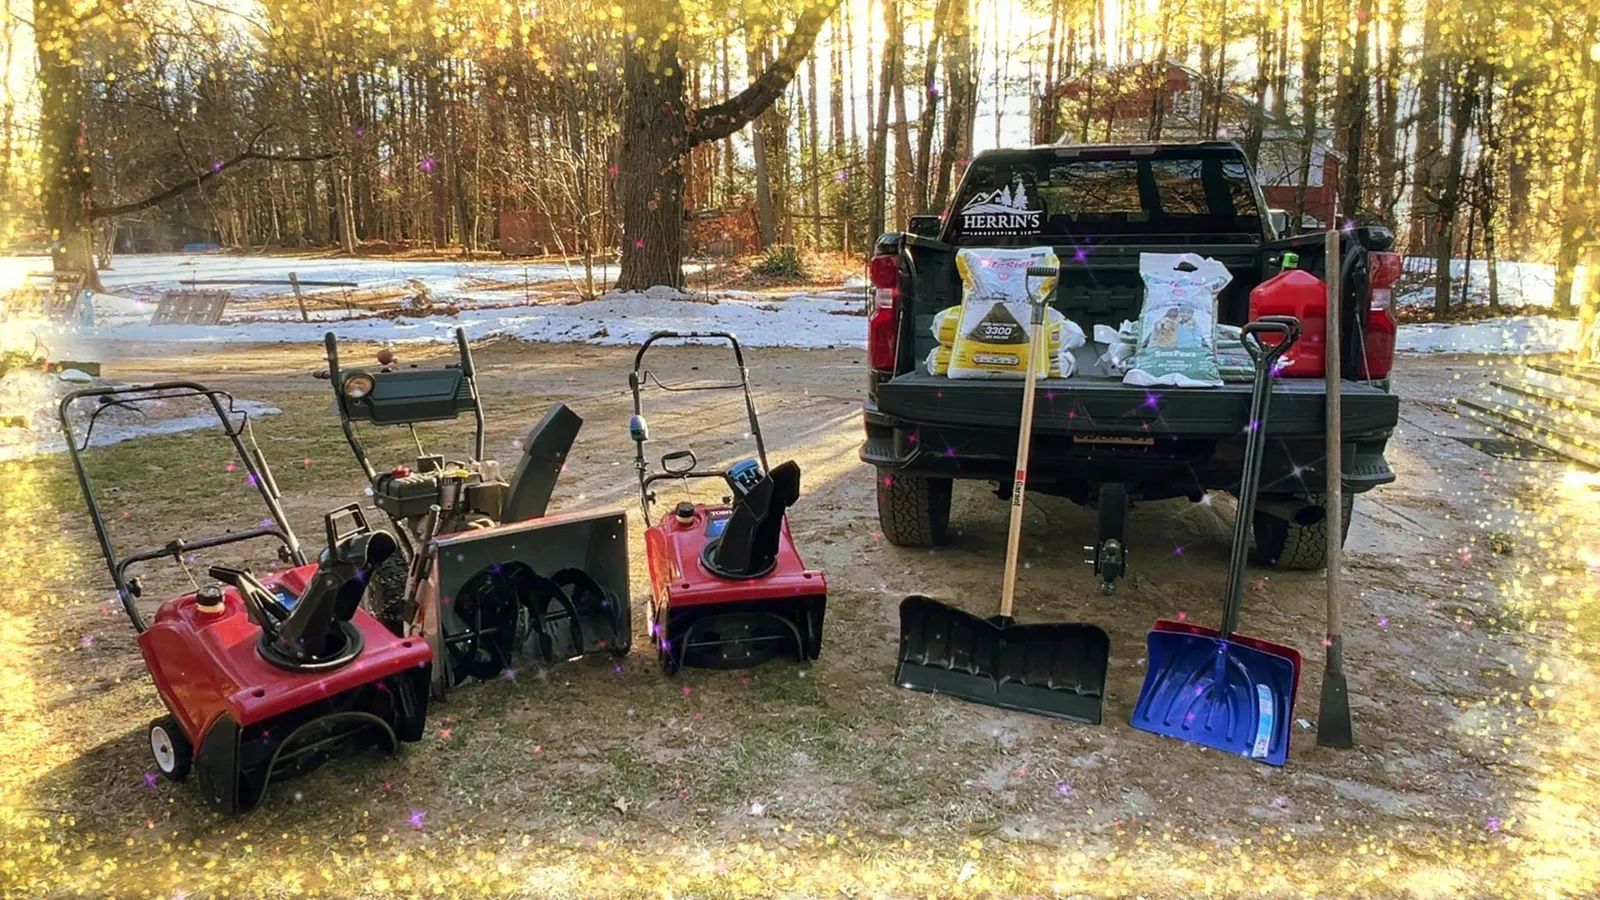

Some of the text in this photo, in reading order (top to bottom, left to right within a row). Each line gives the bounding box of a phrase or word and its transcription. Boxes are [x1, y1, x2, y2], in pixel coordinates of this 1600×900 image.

[963, 214, 1040, 228] HERRIN'S
[985, 326, 1012, 335] 3300
[1013, 480, 1023, 507] Garant
